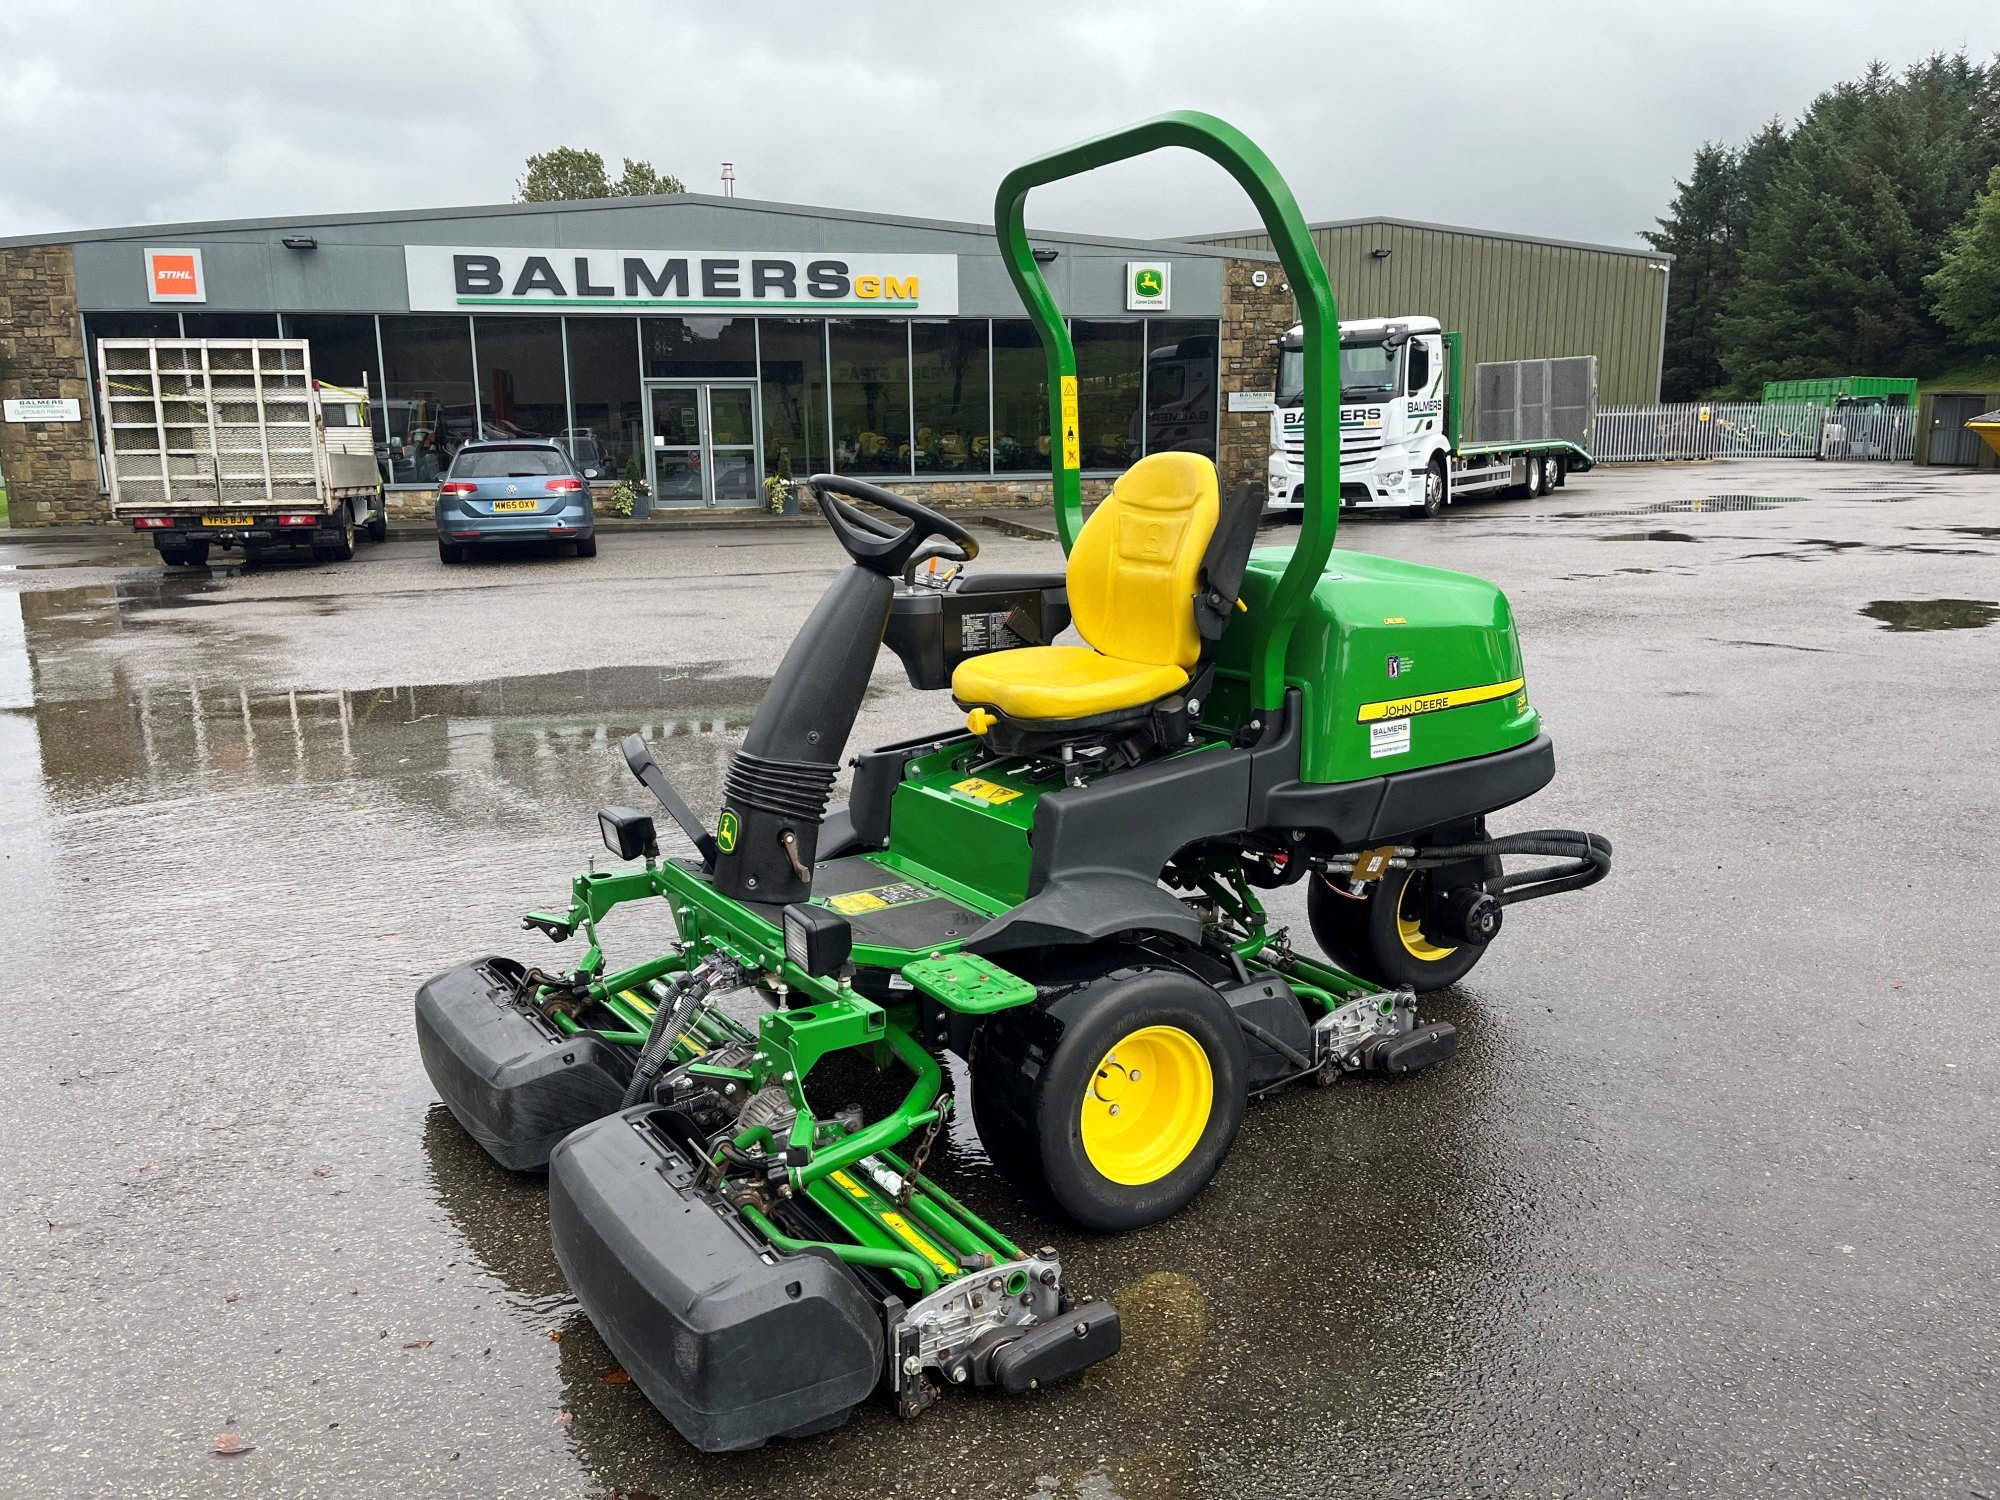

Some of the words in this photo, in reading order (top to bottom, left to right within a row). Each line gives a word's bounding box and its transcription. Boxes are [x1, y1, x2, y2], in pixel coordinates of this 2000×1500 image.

[157, 270, 193, 279] STIHL
[453, 254, 851, 298] BALMERS
[854, 275, 919, 298] GM
[1407, 400, 1442, 413] BALMERS
[1284, 408, 1381, 424] BAERS
[494, 502, 517, 510] MW65
[518, 501, 535, 509] OXV
[1382, 703, 1412, 717] JOHN
[1414, 697, 1449, 712] DEERE
[1373, 724, 1408, 736] BALMERS
